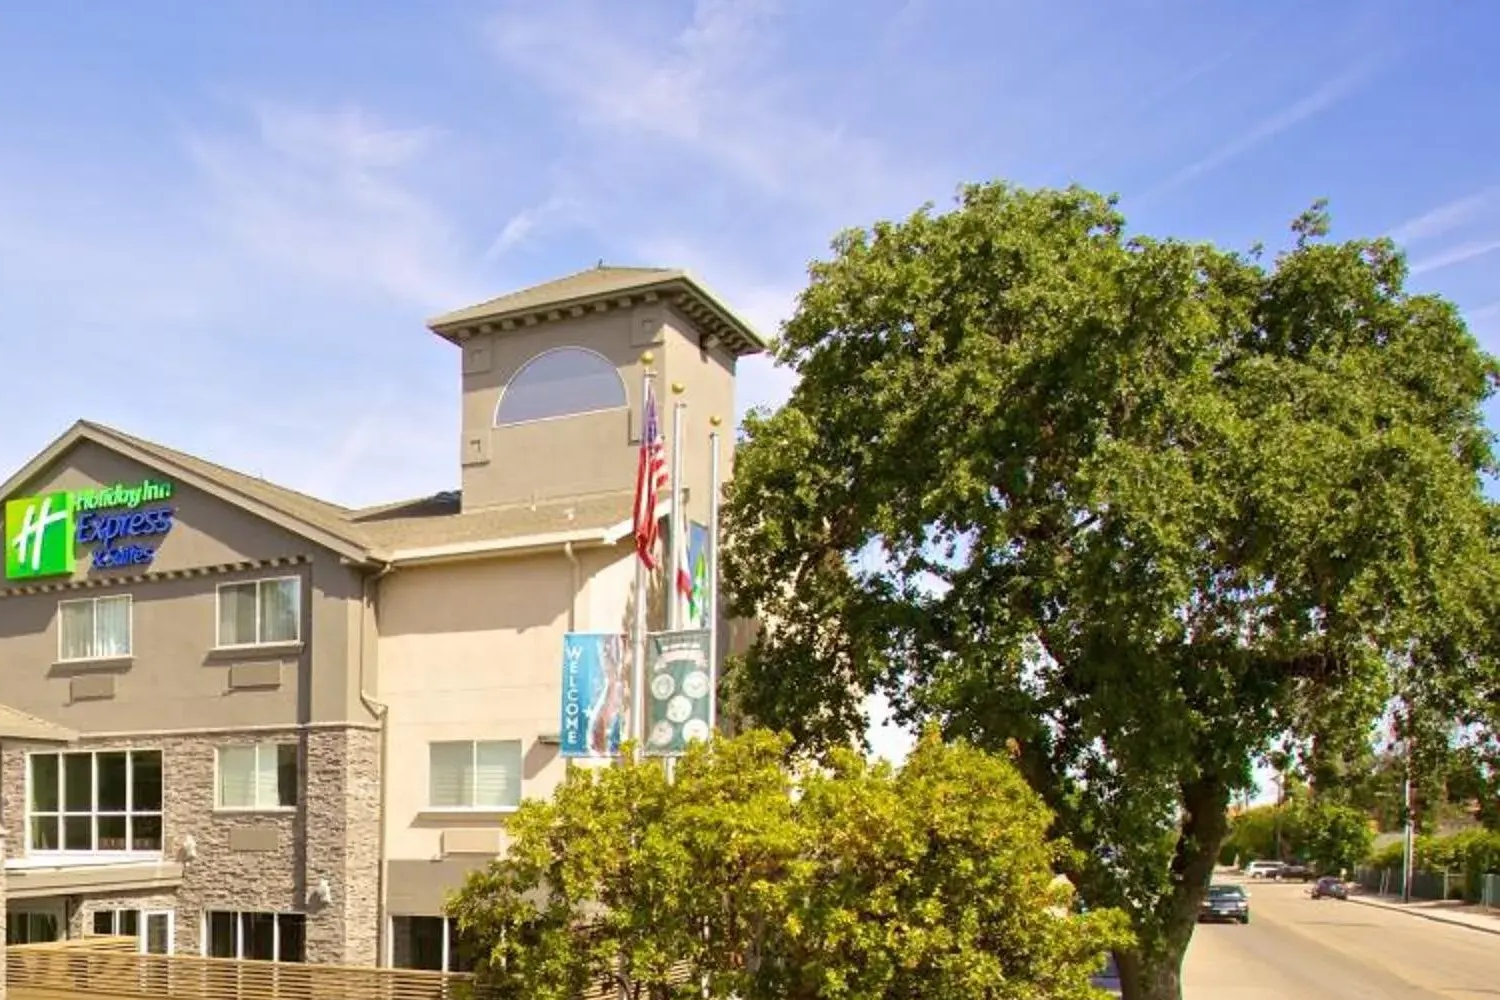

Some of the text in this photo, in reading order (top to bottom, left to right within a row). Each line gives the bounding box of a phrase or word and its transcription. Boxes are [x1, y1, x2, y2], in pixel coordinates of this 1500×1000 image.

[77, 479, 172, 510] Holiday Inn
[76, 507, 174, 548] Express
[565, 641, 583, 745] WELCOME
